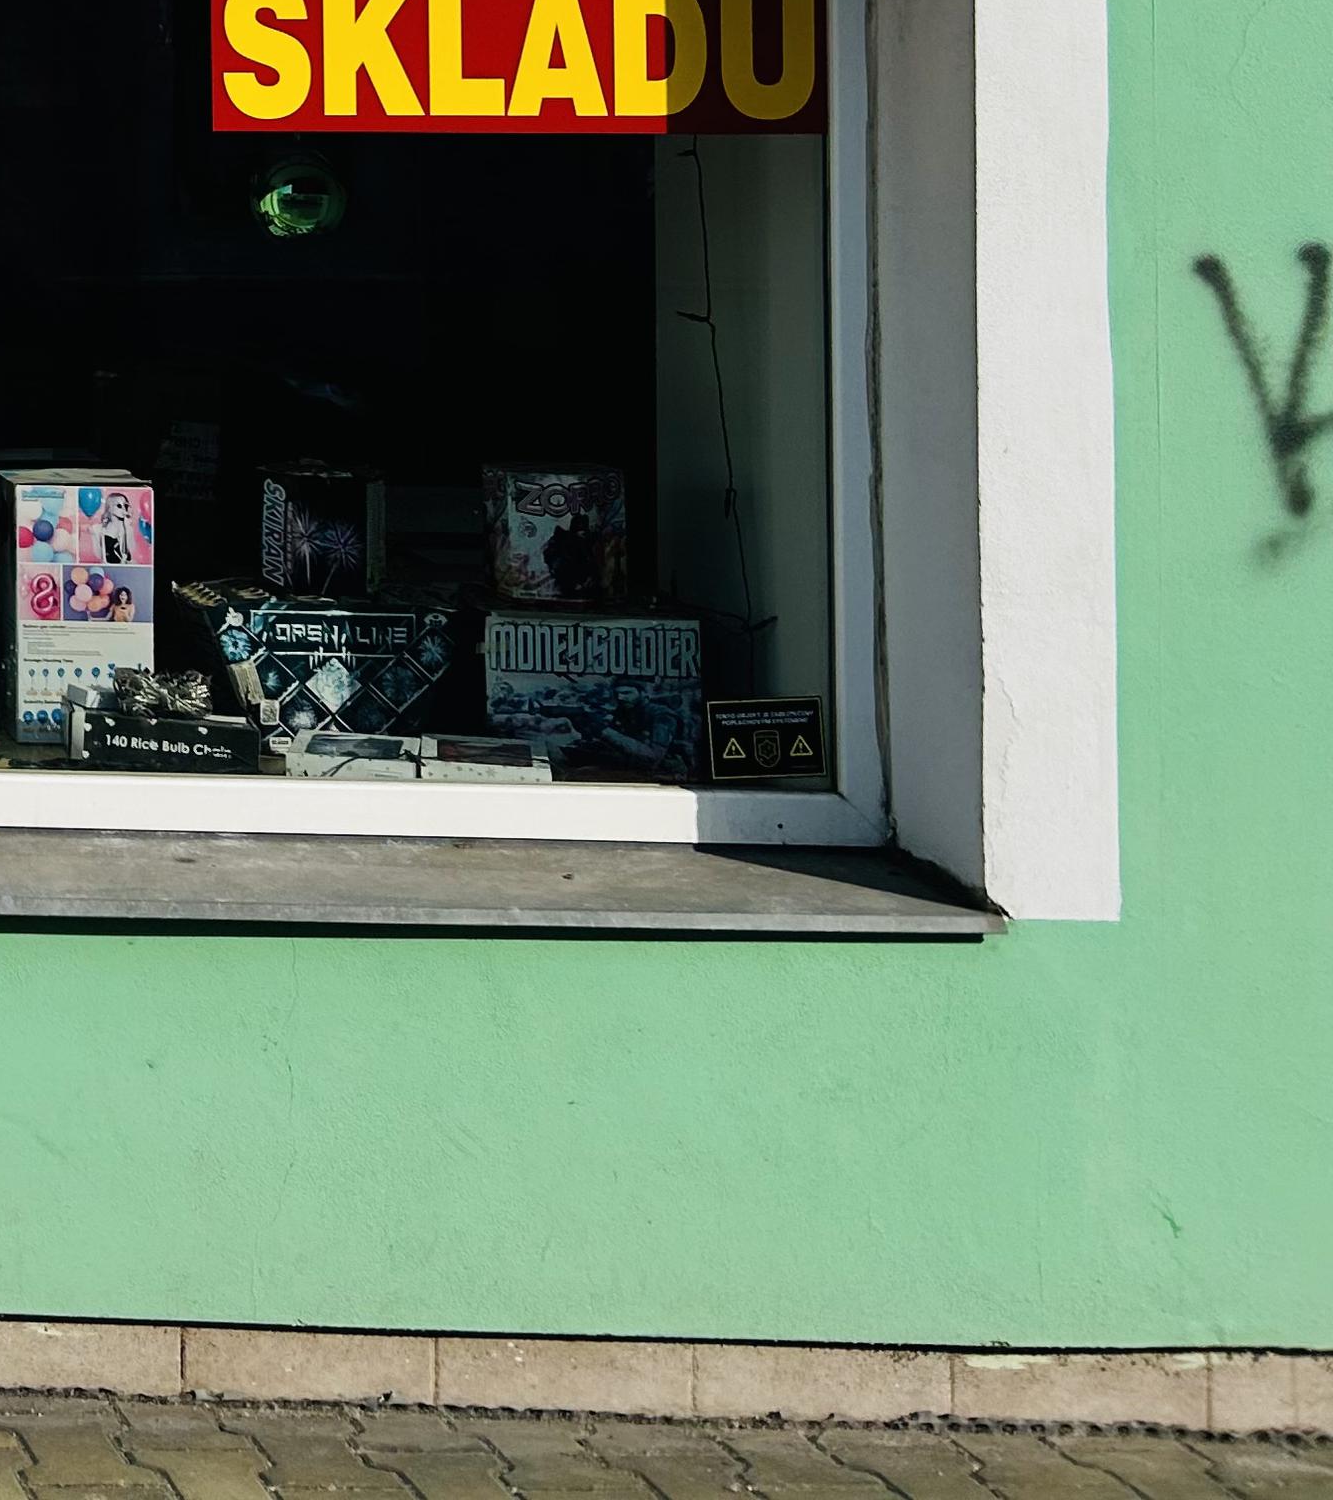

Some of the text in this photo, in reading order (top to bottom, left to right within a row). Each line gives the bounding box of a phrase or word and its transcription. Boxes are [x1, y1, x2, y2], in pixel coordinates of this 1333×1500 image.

[515, 472, 622, 517] ZORRO
[591, 627, 700, 678] SOLDIER
[105, 734, 128, 747] 140
[131, 737, 159, 751] Rice
[162, 740, 190, 754] Bulb
